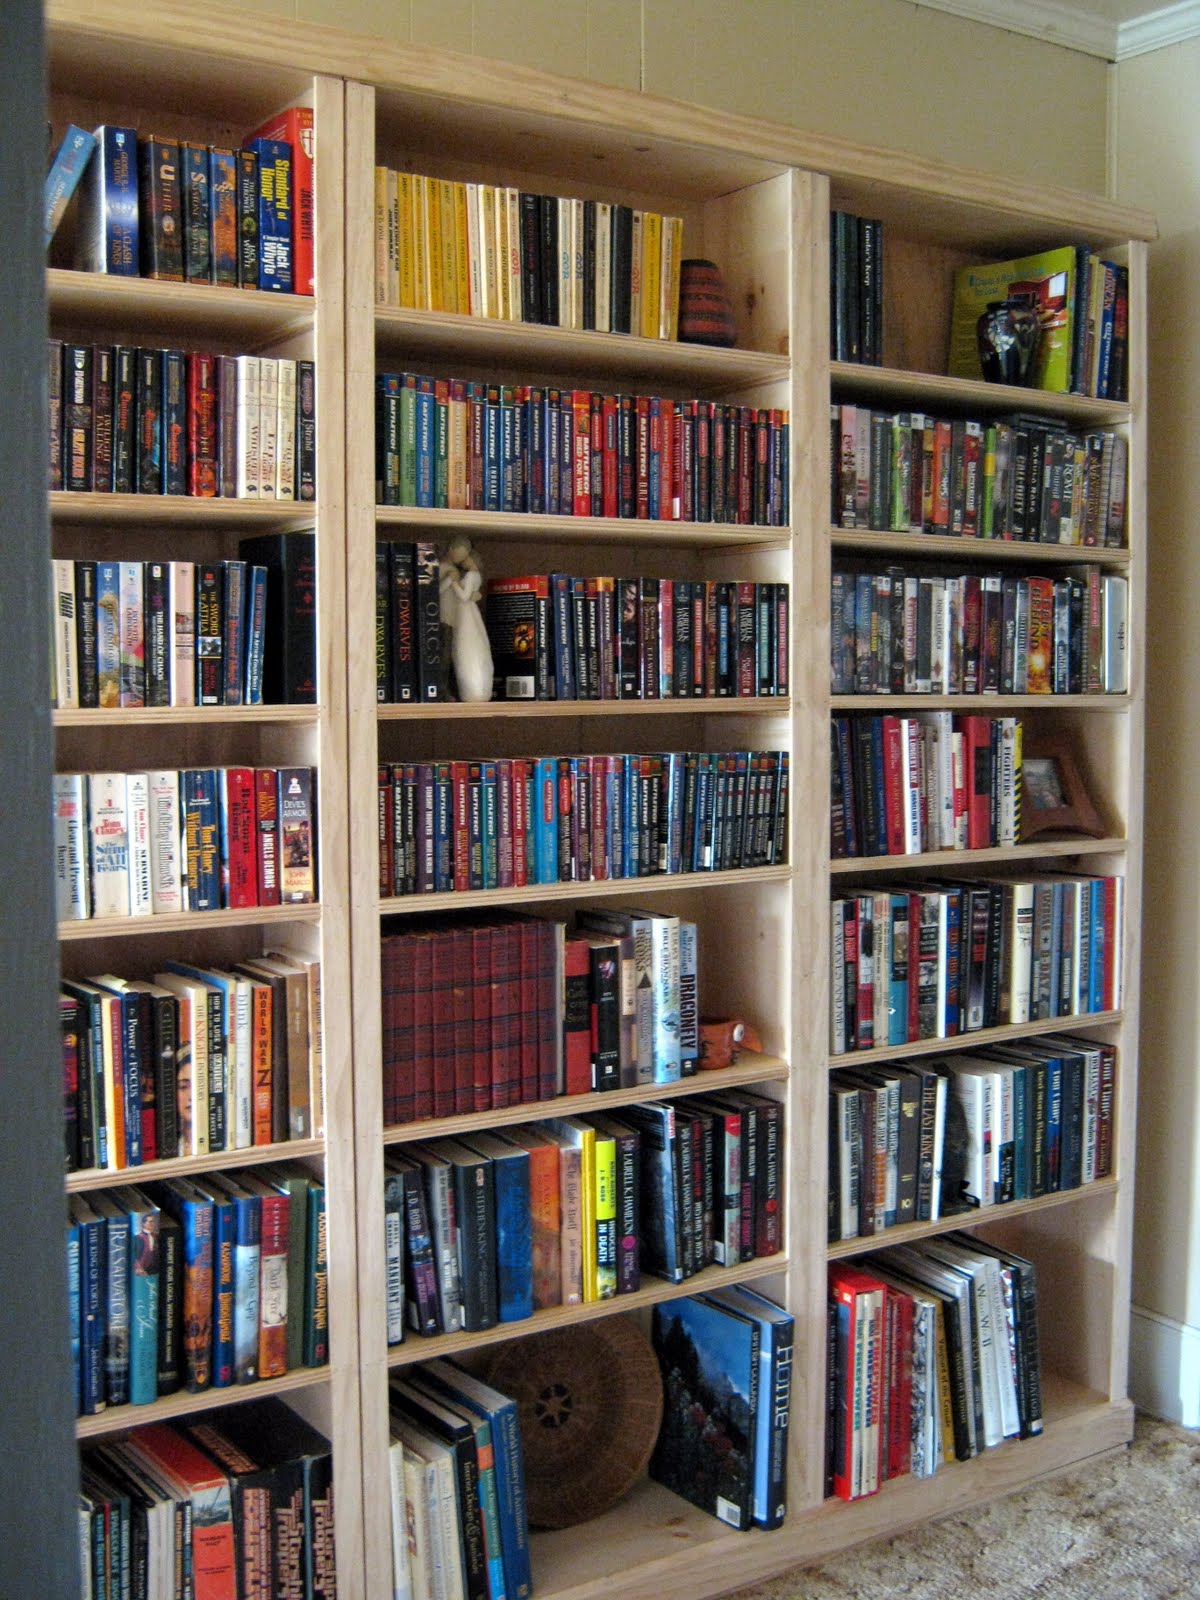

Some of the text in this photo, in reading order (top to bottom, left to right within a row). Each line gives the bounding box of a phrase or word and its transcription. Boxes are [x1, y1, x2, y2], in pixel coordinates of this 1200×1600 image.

[261, 168, 276, 200] Honor
[276, 159, 289, 220] Standard of
[301, 188, 312, 240] JACK WHYTE
[113, 240, 122, 265] KINGS
[123, 236, 131, 264] CLASH
[262, 242, 276, 274] Whyte
[277, 243, 289, 268] Jack
[511, 248, 520, 275] GOR
[59, 591, 74, 619] YEAGER
[201, 602, 209, 633] ATTILA
[210, 603, 219, 635] SWORD
[400, 599, 410, 661] DWARVES
[425, 602, 440, 664] ORCS
[910, 771, 918, 784] DAY
[1003, 747, 1011, 797] FIGHTERS
[241, 788, 251, 854] Red Storm
[259, 792, 268, 817] BROWN
[283, 809, 307, 817] ARMOR
[284, 800, 306, 809] DEVIL'S
[95, 826, 125, 836] Clancy
[102, 820, 121, 828] Tom
[232, 803, 240, 842] Rising
[57, 846, 67, 880] Danger
[69, 845, 80, 864] and
[96, 845, 127, 853] Sum
[107, 854, 127, 865] All
[187, 812, 201, 889] Without Remorse
[200, 824, 216, 874] Tom Clancy
[263, 834, 275, 888] ANGELS DEMONS
[69, 867, 80, 904] Present
[97, 864, 127, 872] Fears
[140, 849, 148, 902] SUBMARINE
[993, 894, 1001, 953] FLYBOYS
[949, 931, 958, 998] TOM BROKAW
[196, 1005, 204, 1017] THE
[213, 996, 221, 1010] HOW
[214, 1013, 221, 1022] TO
[237, 994, 249, 1030] blink
[680, 974, 696, 1049] DRAGONFLY
[128, 1018, 138, 1049] Power
[195, 1020, 205, 1060] KNIGHT
[256, 992, 271, 1087] WORLD WAR Z
[129, 1062, 138, 1098] FOCUS
[197, 1070, 205, 1102] HISTORY
[213, 1054, 222, 1093] BATTLE
[1099, 1056, 1113, 1120] Tom Clancy
[1036, 1092, 1044, 1120] Storm
[1049, 1070, 1061, 1125] Tom Clancy
[877, 1093, 886, 1147] COMBAT JUMP
[921, 1087, 934, 1158] THE LAST KING
[984, 1104, 992, 1129] Clancy
[1087, 1117, 1095, 1143] Shadow
[768, 1121, 777, 1152] LAURELL
[1034, 1122, 1043, 1152] Rising
[624, 1153, 634, 1185] LAURELL
[681, 1141, 690, 1173] LAURELL
[767, 1163, 776, 1199] HAMILTON
[624, 1196, 633, 1234] HAMILTON
[682, 1184, 692, 1221] HAMILTON
[194, 1208, 203, 1237] Jordan
[202, 1207, 211, 1237] Robert
[476, 1189, 487, 1259] STEPHEN KING
[166, 1237, 174, 1264] SUPPORT
[598, 1223, 607, 1262] IN DEATH
[90, 1268, 97, 1280] OF
[388, 1257, 400, 1304] MANHUNT
[90, 1283, 98, 1309] TORTS
[109, 1254, 127, 1333] SALVATORE
[166, 1283, 174, 1302] LOCAL
[166, 1304, 174, 1328] WIZARD
[774, 1346, 793, 1428] Home
[854, 1342, 864, 1431] FIREPOWER
[865, 1340, 874, 1428] FIREPOWER
[872, 1337, 882, 1425] FIREPOWER
[1029, 1371, 1039, 1418] AVIATION
[507, 1413, 524, 1550] A World History of Architecture
[463, 1461, 479, 1574] Interior Design & Furniture
[311, 1499, 328, 1590] Troopers
